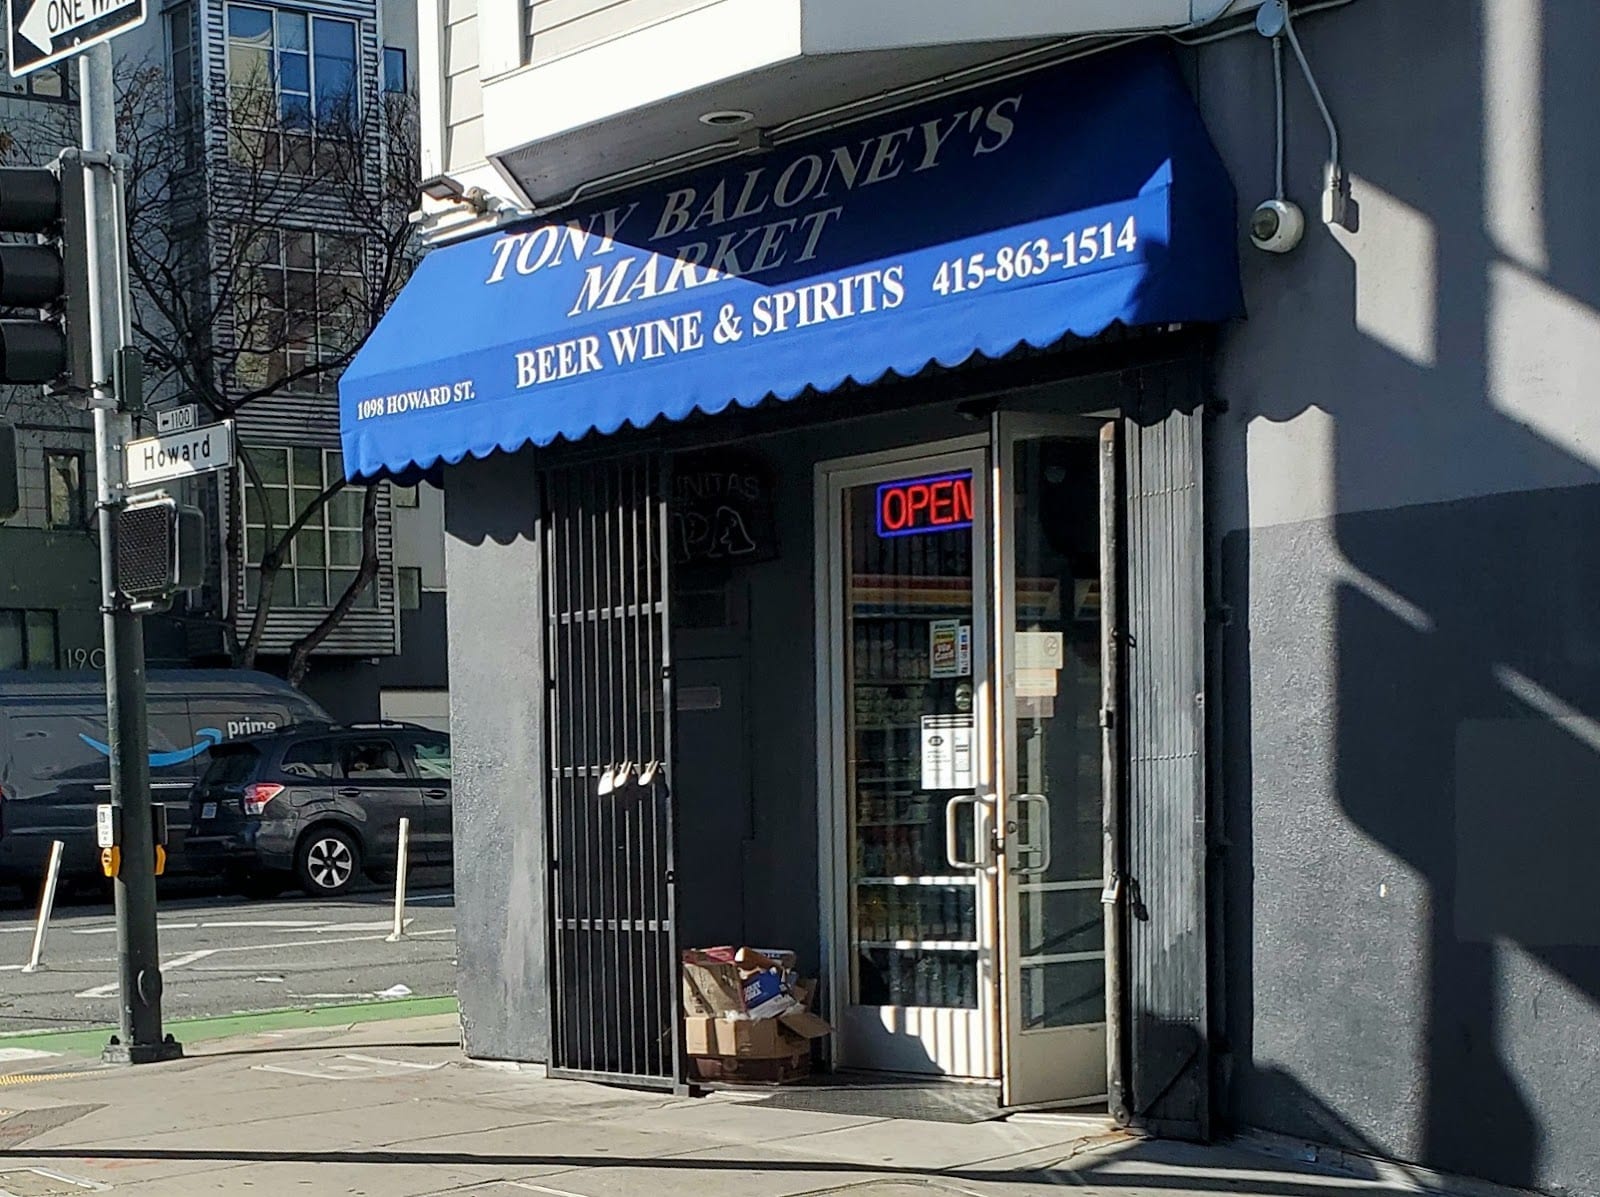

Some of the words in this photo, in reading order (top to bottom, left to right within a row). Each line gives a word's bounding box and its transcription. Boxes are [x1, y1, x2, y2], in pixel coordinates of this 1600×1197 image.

[47, 0, 85, 33] ONE
[485, 202, 640, 285] TONY
[648, 94, 1023, 242] BALONEY'S
[567, 206, 843, 318] MARKET
[931, 215, 1137, 297] 415-863-1514
[514, 334, 604, 390] BEER
[606, 311, 703, 366] WINE
[712, 303, 743, 343] &
[751, 266, 905, 339] SPIRITS
[171, 408, 191, 429] 1100
[357, 398, 384, 421] 1098
[386, 386, 451, 415] HOWARD
[453, 380, 476, 402] ST.
[143, 433, 211, 471] Howard
[883, 479, 975, 530] OPEN
[227, 716, 277, 739] prime
